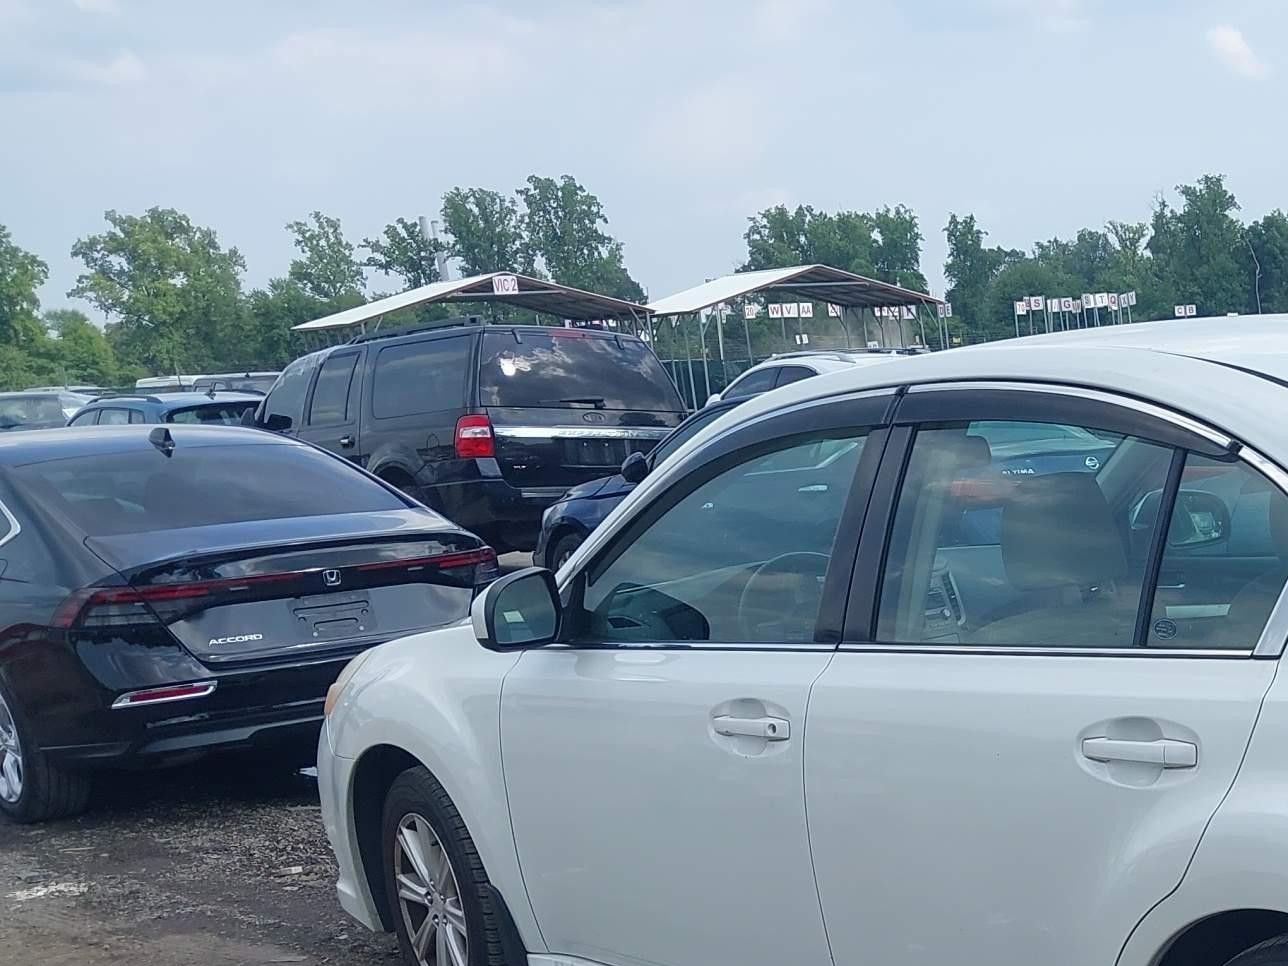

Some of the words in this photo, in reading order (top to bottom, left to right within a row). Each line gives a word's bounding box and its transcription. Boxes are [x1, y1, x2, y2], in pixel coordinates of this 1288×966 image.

[493, 278, 509, 292] VIC
[511, 278, 517, 291] 2
[1033, 299, 1041, 308] S
[1063, 300, 1071, 309] G
[770, 306, 781, 315] W
[208, 633, 263, 647] ACCORD
